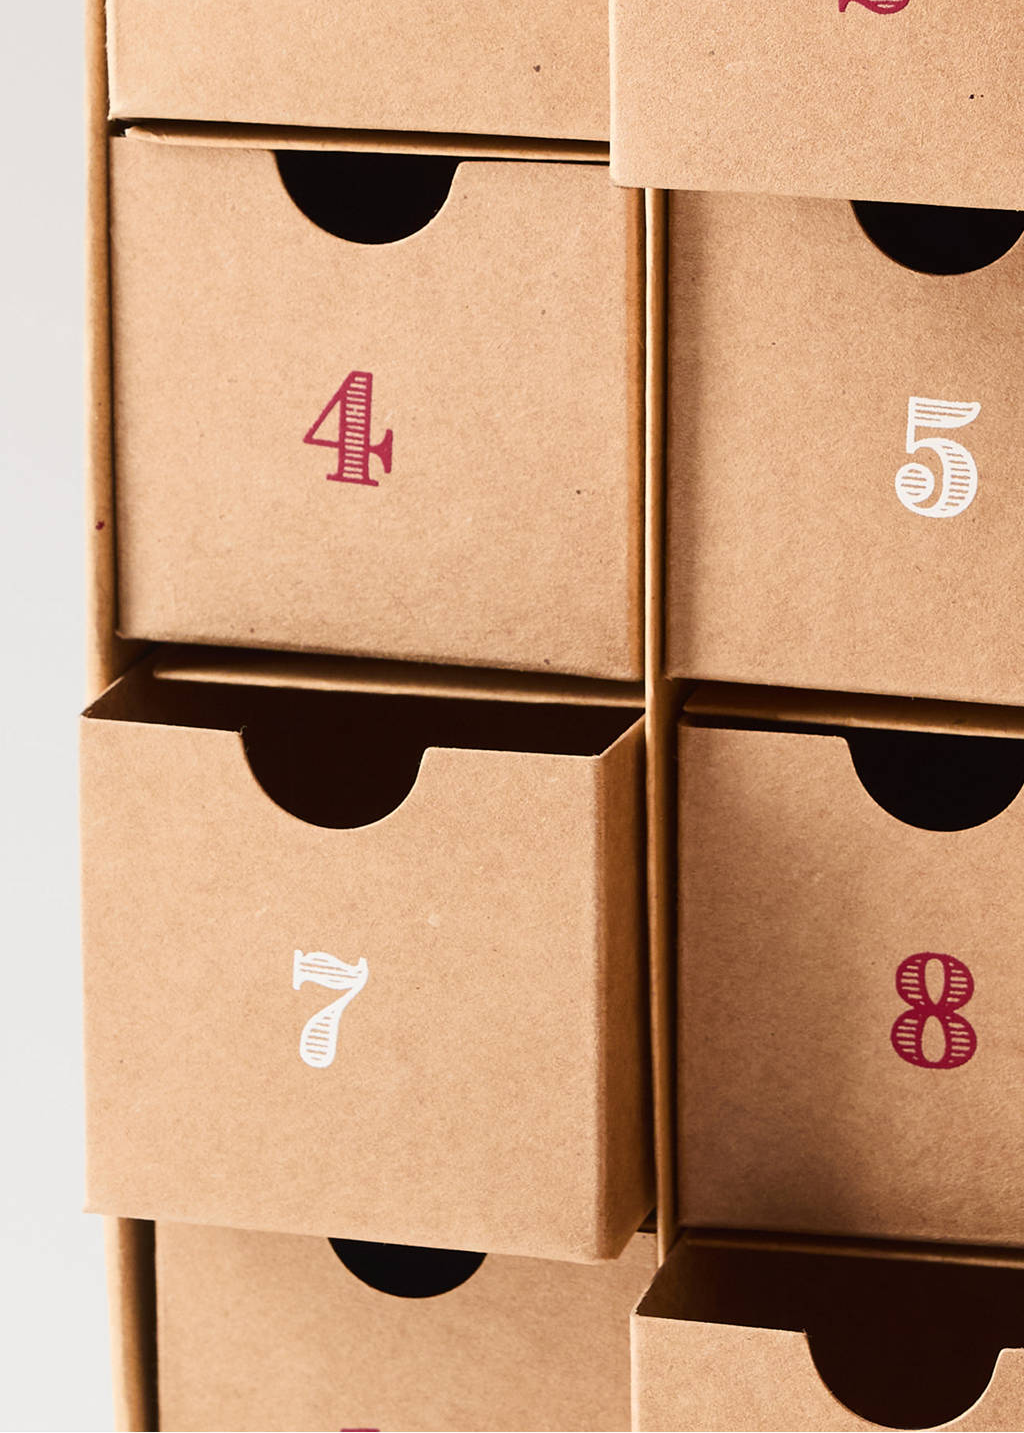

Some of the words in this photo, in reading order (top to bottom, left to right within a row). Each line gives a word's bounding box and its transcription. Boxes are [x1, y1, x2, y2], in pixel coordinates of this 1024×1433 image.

[303, 370, 394, 487] 4
[894, 396, 982, 519] 5
[292, 949, 370, 1069] 7
[889, 951, 977, 1071] 8
